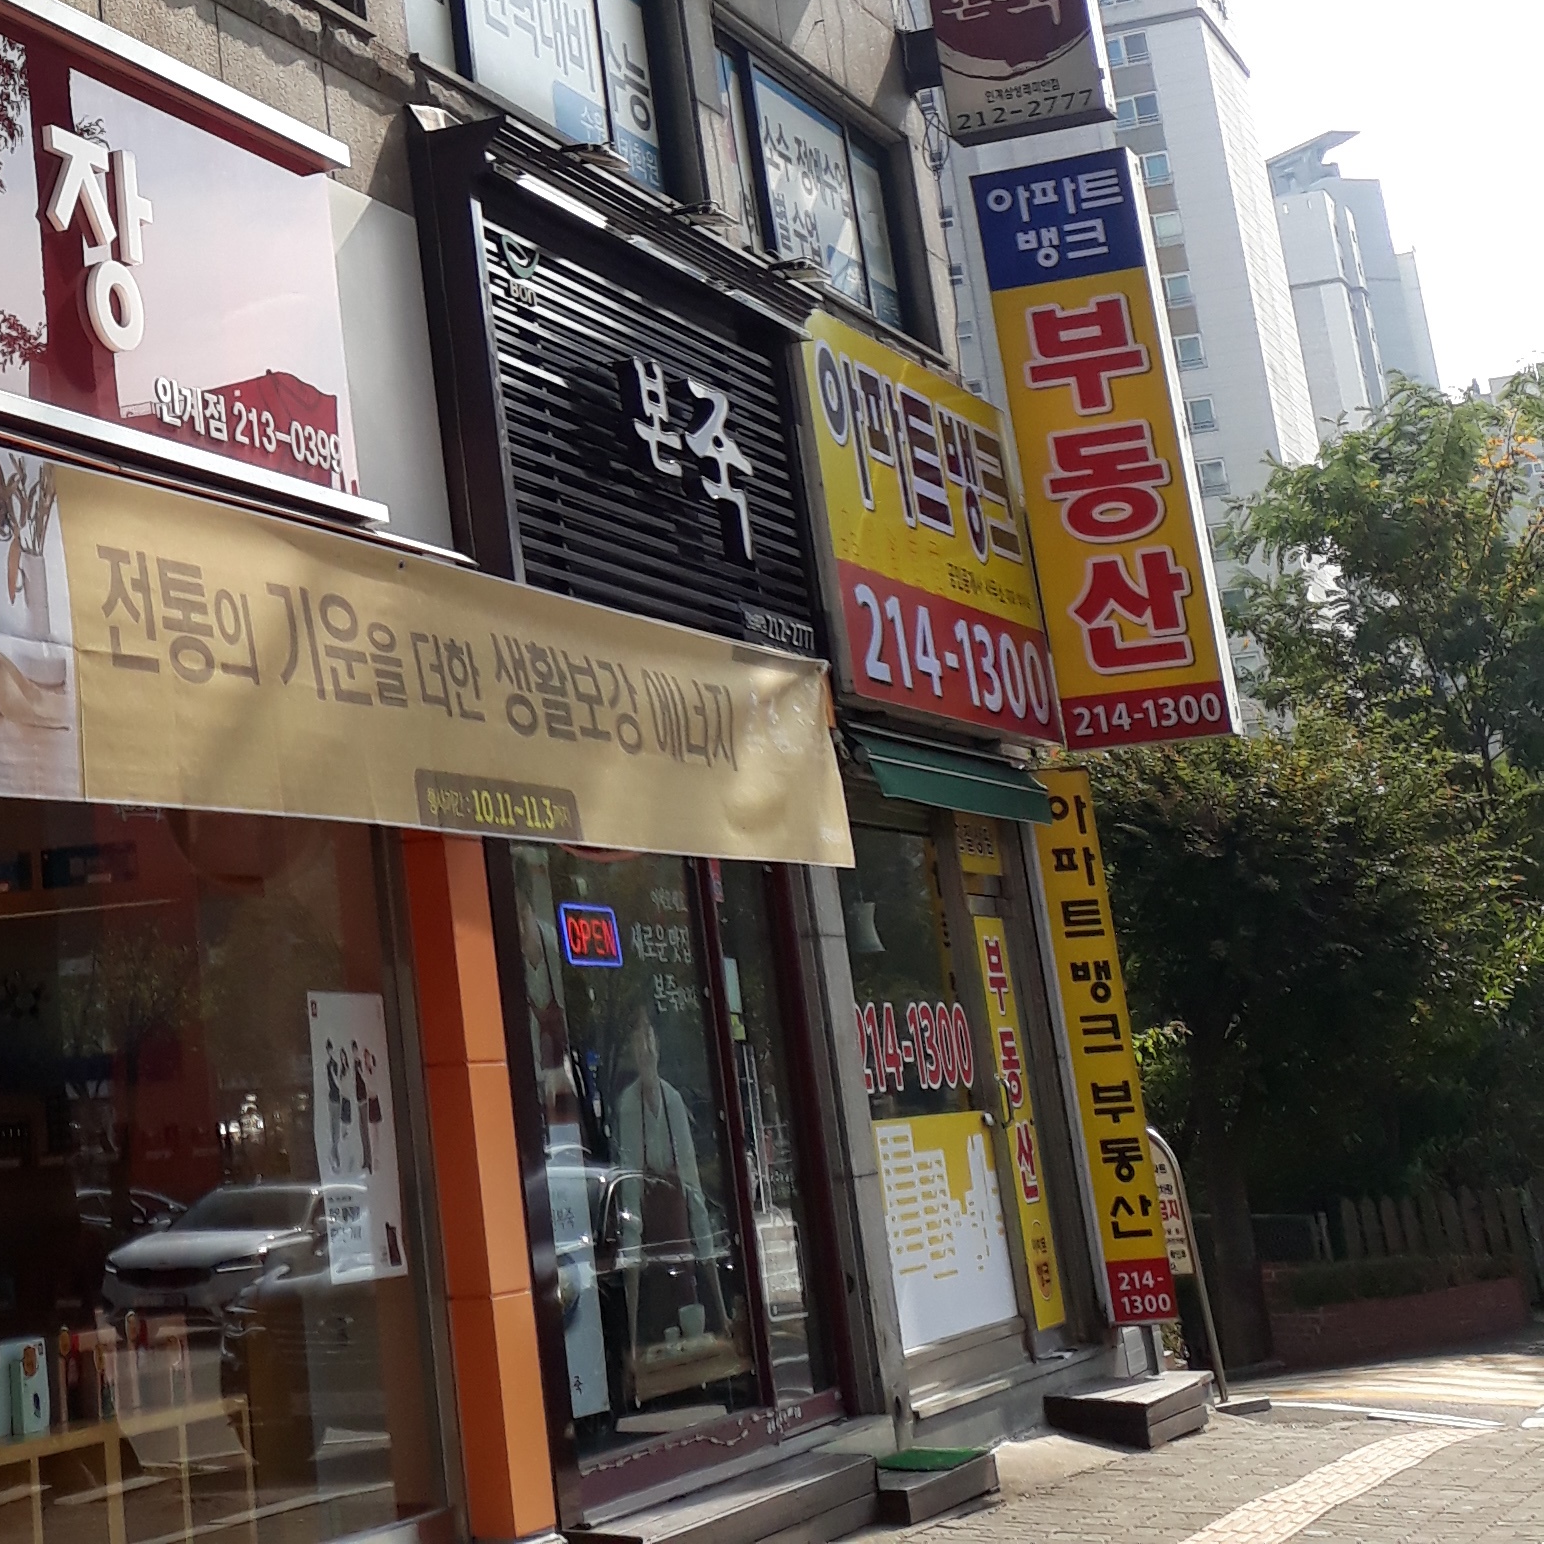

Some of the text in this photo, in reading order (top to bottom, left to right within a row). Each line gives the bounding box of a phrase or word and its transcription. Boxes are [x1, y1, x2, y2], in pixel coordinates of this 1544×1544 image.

[957, 89, 1093, 131] 212-2777
[986, 168, 1124, 223] 아파트
[1016, 218, 1109, 268] 뱅크
[233, 401, 342, 474] 213-0399
[633, 356, 754, 561] 본죽
[815, 338, 1025, 564] 아파트뱅크
[1025, 293, 1195, 675] 부동산
[96, 543, 740, 771] 전통의 기운을 더한 생활보강 에너지
[855, 583, 1051, 726] 214-1300
[1072, 692, 1222, 737] 214-1300
[567, 917, 617, 956] OPEN
[857, 1001, 974, 1094] 214-1300
[983, 936, 1040, 1203] 부동산
[1117, 1271, 1164, 1294] 214-
[1121, 1293, 1171, 1315] 1300
